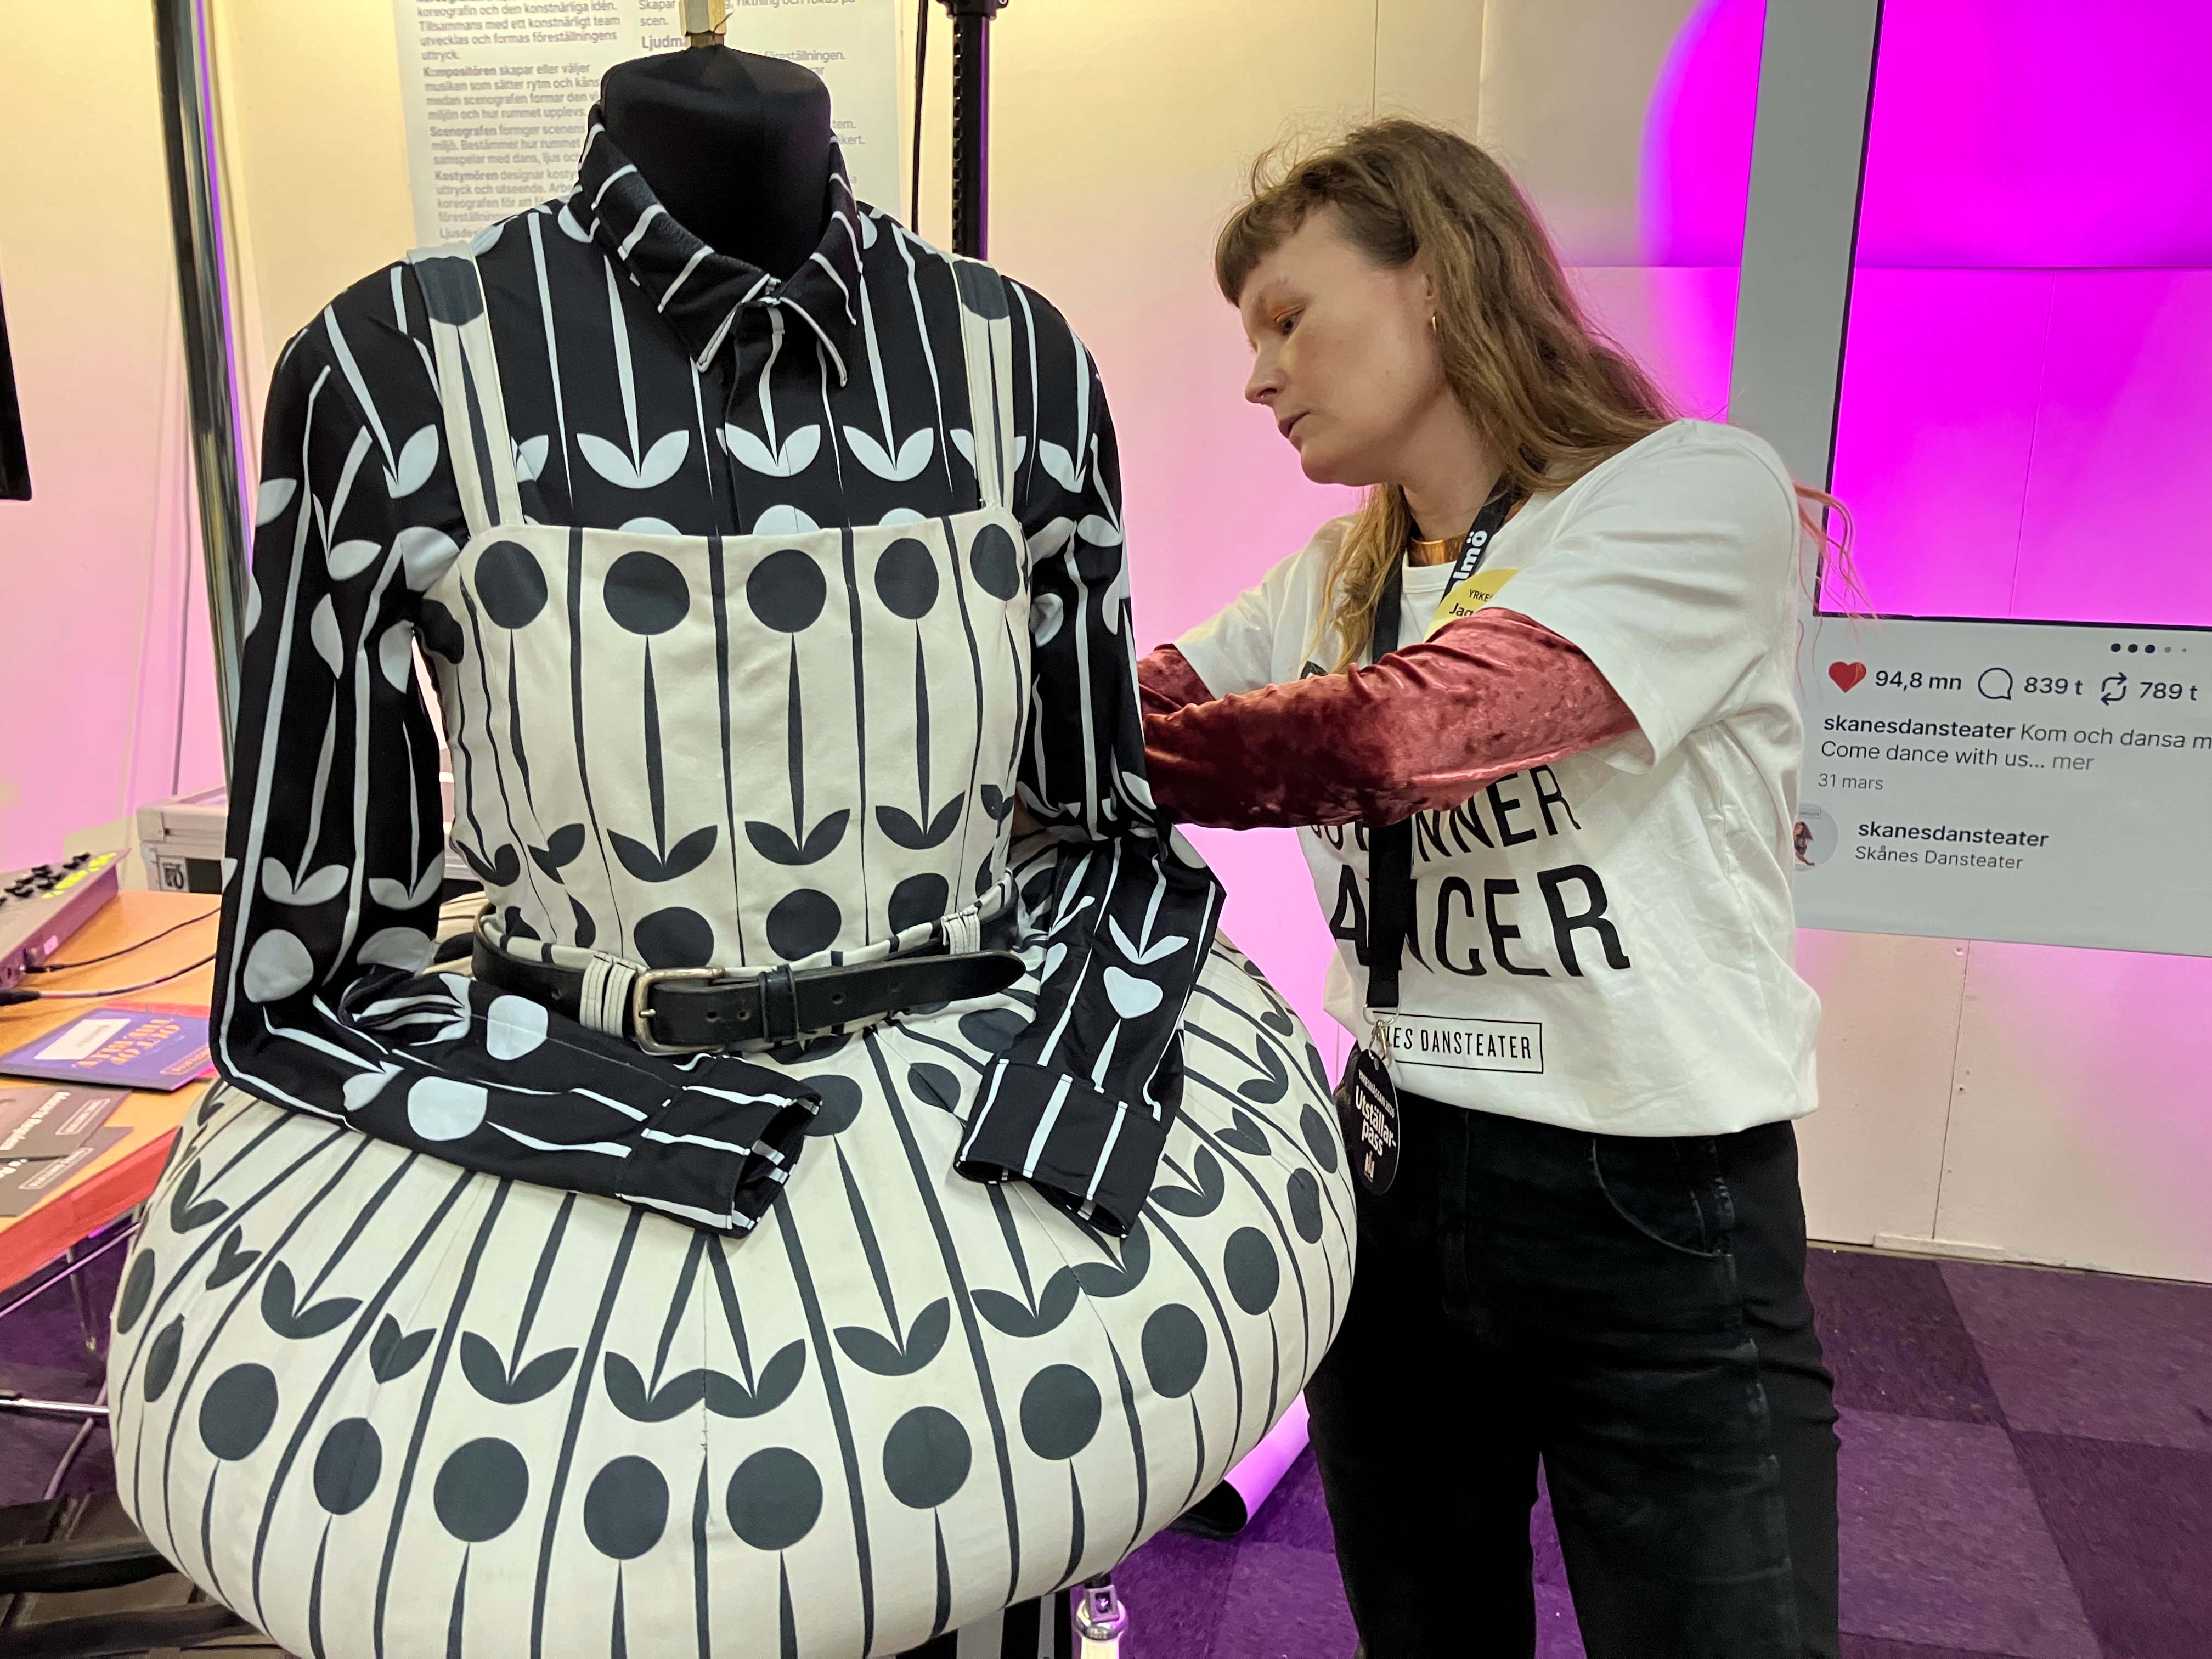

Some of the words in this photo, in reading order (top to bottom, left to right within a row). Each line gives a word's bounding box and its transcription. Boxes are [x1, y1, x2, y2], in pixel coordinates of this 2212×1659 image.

[485, 19, 508, 29] med
[594, 16, 620, 26] team
[471, 34, 492, 44] och
[642, 35, 684, 51] Ljudm
[553, 78, 573, 88] och
[575, 76, 600, 87] käns
[546, 169, 574, 180] kosty
[549, 183, 571, 192] Arbe
[1453, 530, 1488, 579] lmö
[1875, 670, 1922, 691] 94,8
[1928, 677, 1962, 691] mn
[2024, 677, 2068, 695] 839
[2075, 680, 2083, 696] t
[2140, 682, 2183, 700] 789
[2190, 685, 2198, 701] t
[1824, 715, 2016, 740] skanesdansteater
[2021, 723, 2067, 742] Kom
[2074, 728, 2113, 745] och
[2120, 729, 2186, 748] dansa
[1821, 740, 1880, 759] Come
[1886, 744, 1949, 763] dance
[1956, 748, 1997, 766] with
[2005, 753, 2045, 769] us...
[2053, 756, 2095, 771] mer
[1818, 773, 1836, 788] 31
[1842, 777, 1883, 791] mars
[1413, 764, 1582, 862] NNER
[1858, 821, 2050, 847] skanesdansteater
[1855, 845, 1918, 863] Skånes
[1925, 850, 2024, 870] Dansteater
[1329, 864, 1631, 977] ACER
[1421, 1030, 1531, 1059] DANSTEATER
[1356, 1085, 1396, 1147] Utställar-
[1361, 1118, 1384, 1156] pass
